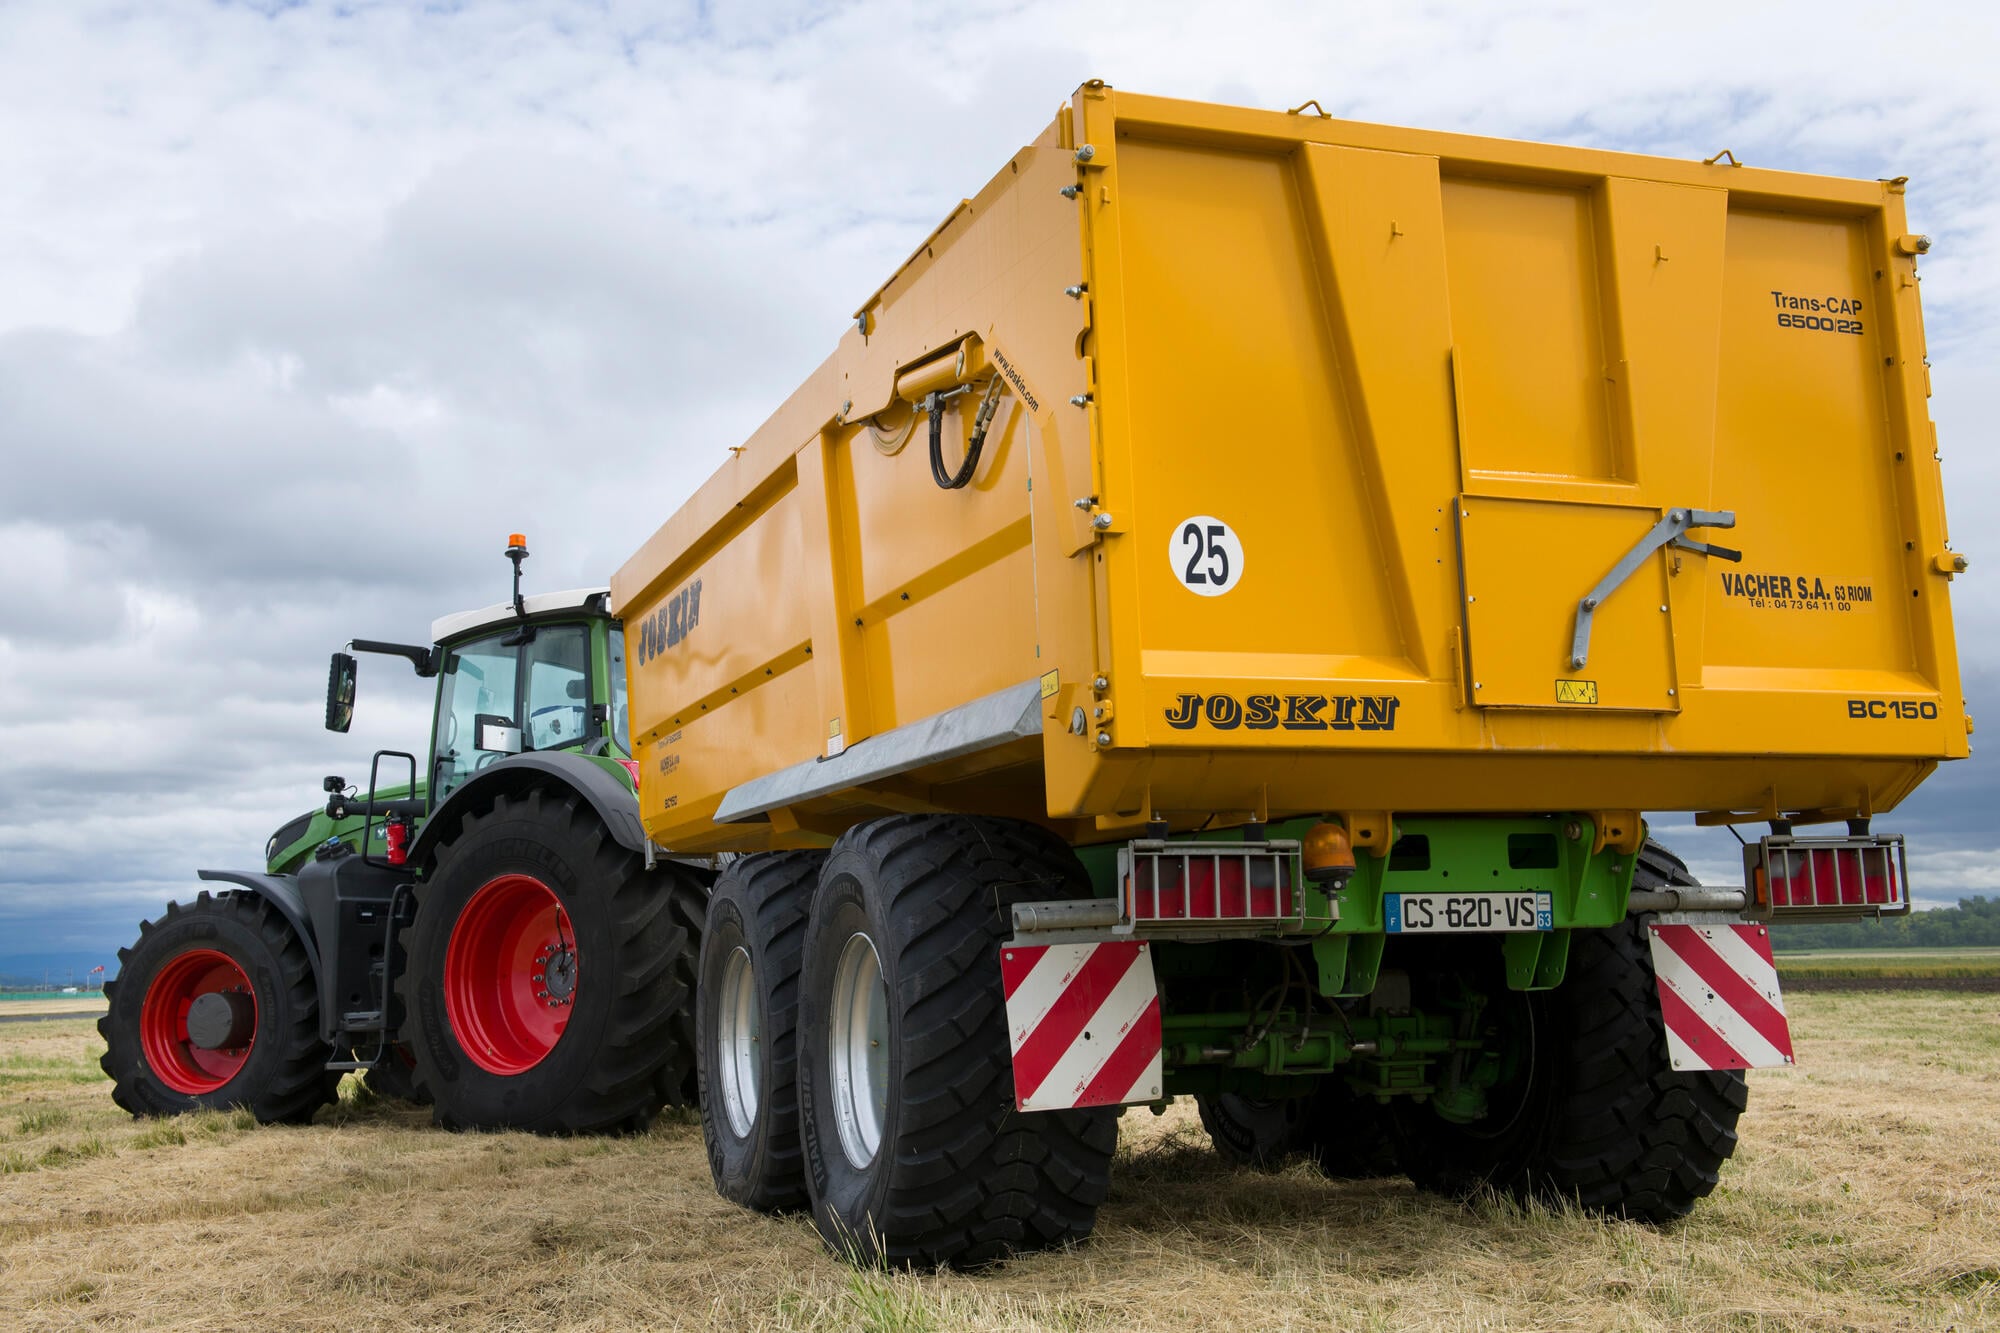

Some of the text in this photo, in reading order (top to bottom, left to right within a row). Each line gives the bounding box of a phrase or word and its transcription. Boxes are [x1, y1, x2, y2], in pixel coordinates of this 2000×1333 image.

[1770, 291, 1863, 316] Trans-CAP
[993, 348, 1040, 413] www.joskin.com
[1182, 522, 1230, 587] 25
[1721, 573, 1873, 602] VACHER S.A. 63 RIOM
[639, 579, 703, 667] JOSKIN
[1774, 599, 1787, 609] 04
[1791, 600, 1804, 610] 73
[1806, 600, 1819, 611] 64
[1822, 601, 1835, 611] 11
[1838, 602, 1851, 612] 00
[1164, 693, 1401, 731] JOSKIN
[1847, 700, 1938, 720] BC150
[1389, 897, 1552, 929] F CS-620-VS 63
[800, 1064, 826, 1190] TRAILXBIB
